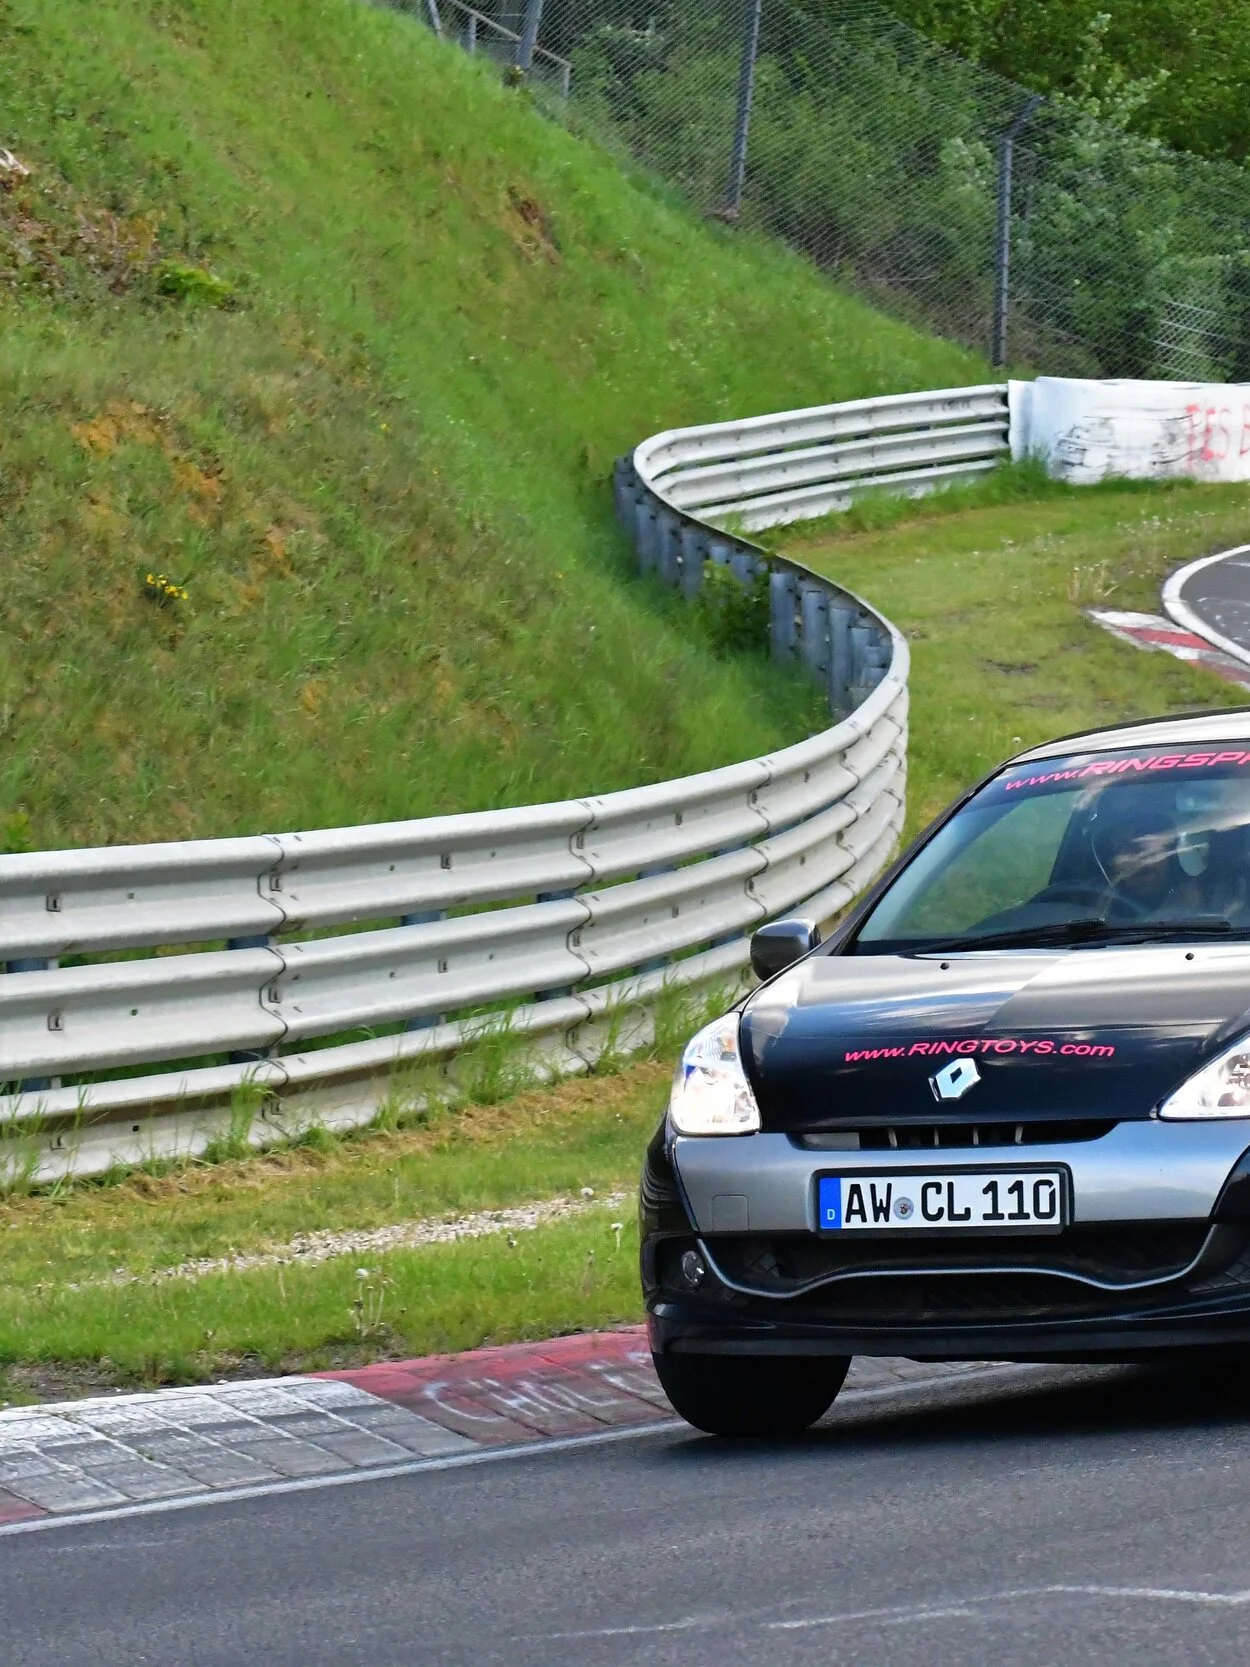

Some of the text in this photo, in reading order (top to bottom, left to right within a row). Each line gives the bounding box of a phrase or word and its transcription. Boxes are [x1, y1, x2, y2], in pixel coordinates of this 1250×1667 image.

[845, 1039, 1115, 1062] www.RINGTOYS.com
[845, 1179, 1056, 1223] AW CL 110
[827, 1208, 836, 1221] D
